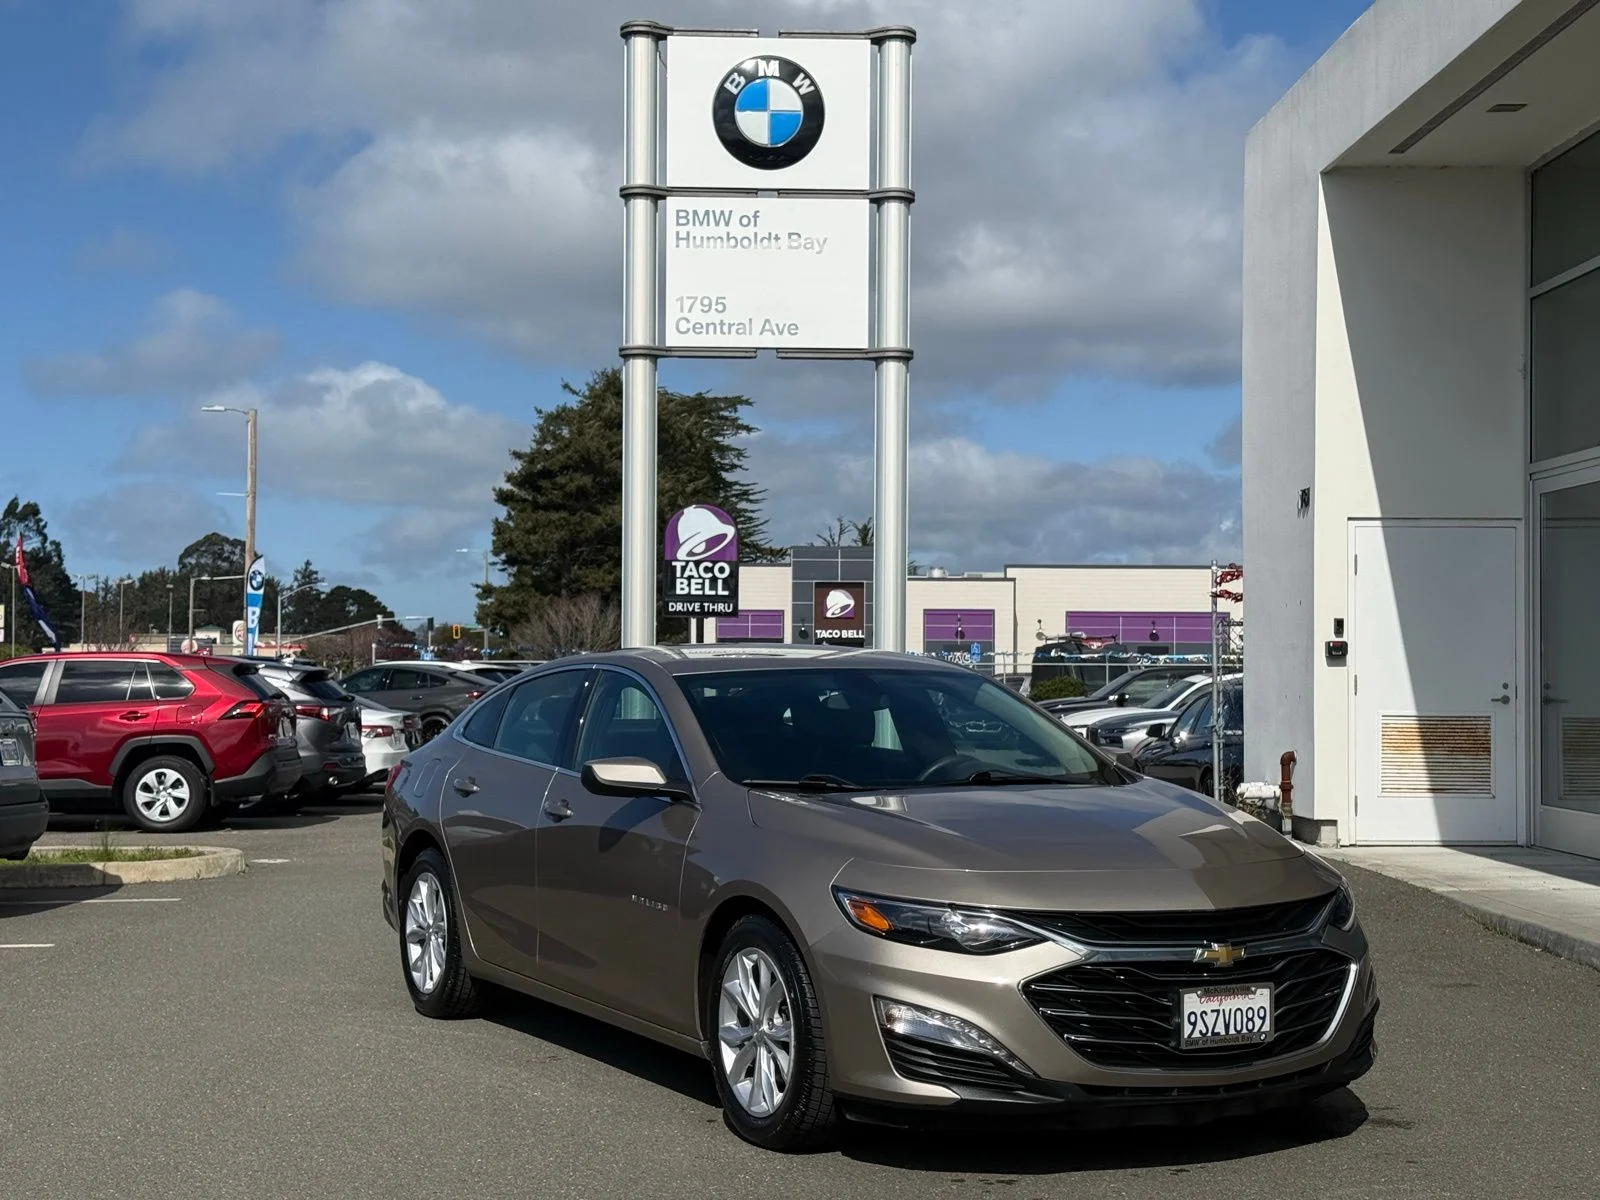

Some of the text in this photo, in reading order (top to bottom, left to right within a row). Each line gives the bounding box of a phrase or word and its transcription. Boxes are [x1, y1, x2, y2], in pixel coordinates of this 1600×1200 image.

[724, 59, 815, 96] BMW
[675, 209, 760, 228] BMW of
[675, 231, 828, 254] Humboldt Bay
[675, 296, 727, 314] 1795
[675, 317, 799, 336] Central Ave
[671, 561, 731, 579] TACO
[675, 578, 730, 596] BELL
[668, 602, 734, 613] DRIVE THRU
[815, 629, 865, 639] TACO BELL
[1187, 1006, 1267, 1039] 9SZV089
